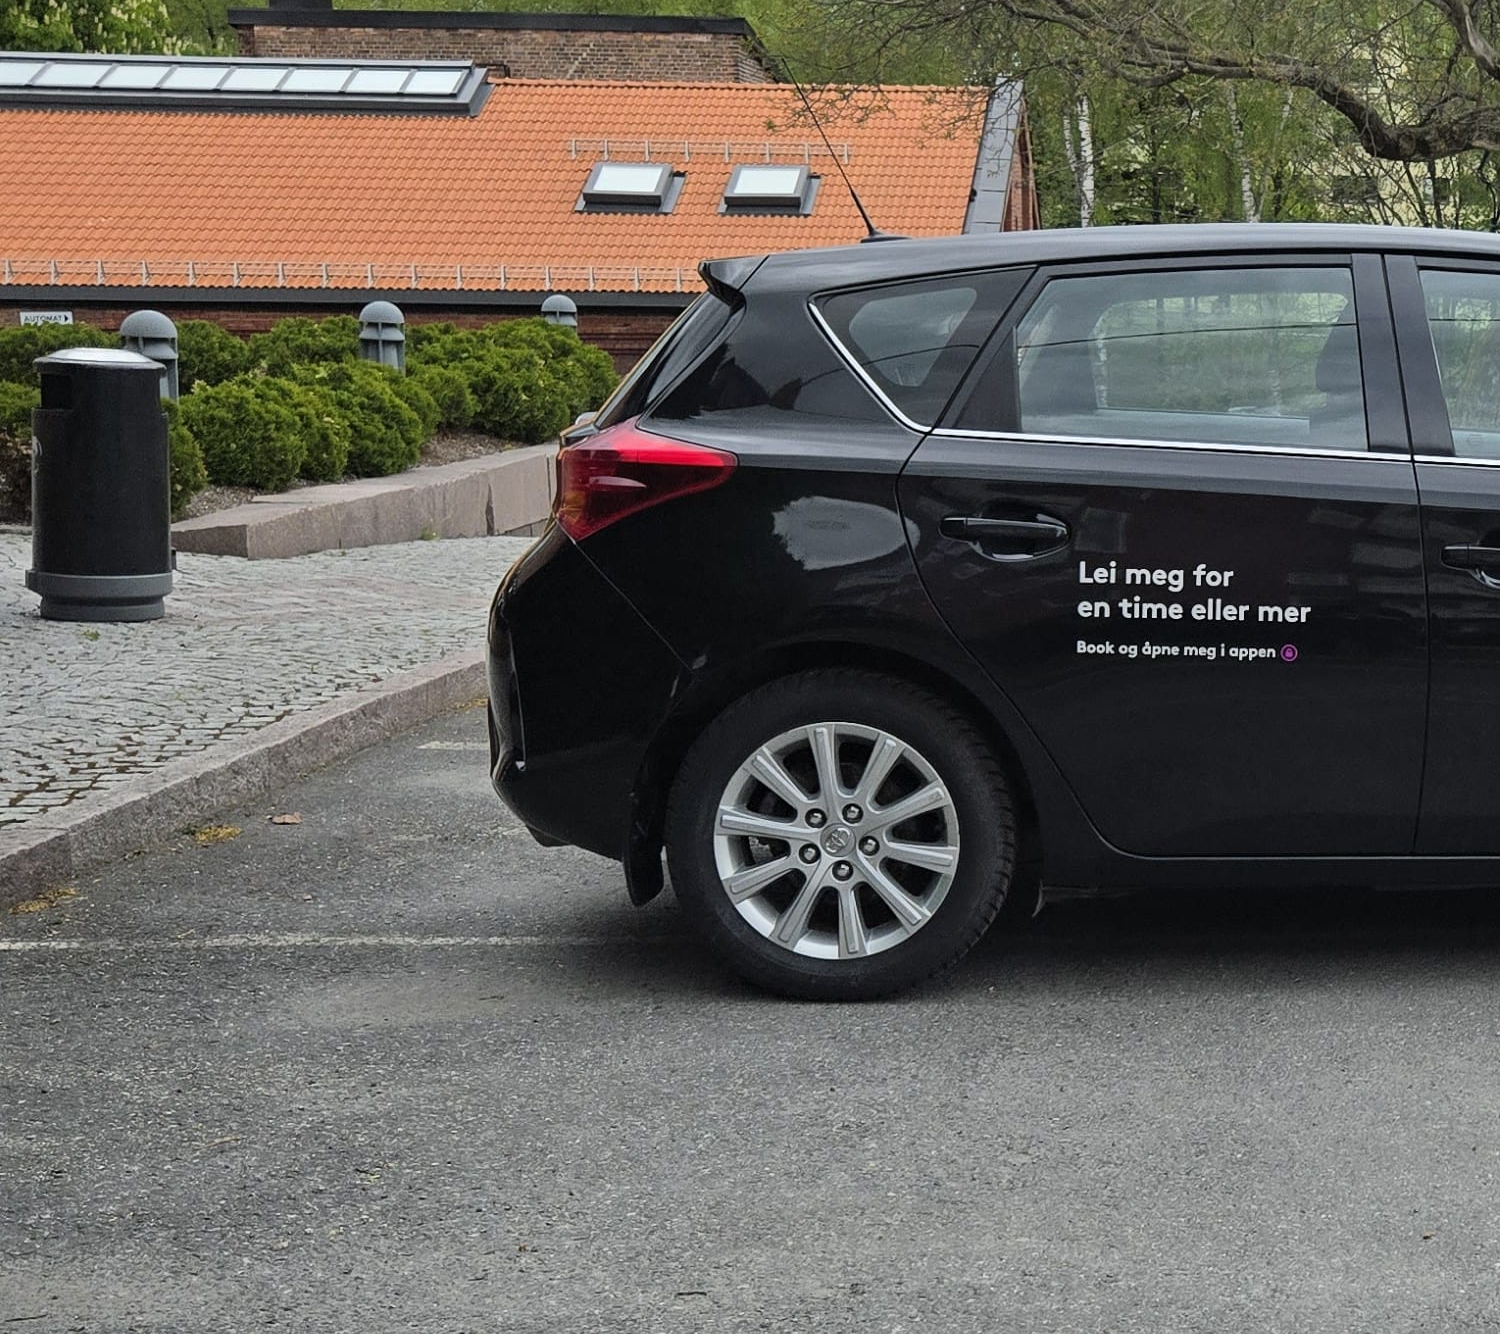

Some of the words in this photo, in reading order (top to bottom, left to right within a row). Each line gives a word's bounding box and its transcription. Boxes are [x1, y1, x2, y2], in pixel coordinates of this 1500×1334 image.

[1079, 560, 1117, 584] Lei
[1125, 568, 1185, 593] meg
[1192, 563, 1234, 587] for
[1077, 600, 1111, 618] en
[1117, 594, 1184, 620] time
[1190, 597, 1250, 621] eller
[1258, 605, 1312, 623] mer
[1076, 640, 1115, 655] Book
[1118, 644, 1138, 659] og
[1141, 641, 1180, 659] åpne
[1183, 645, 1217, 660] meg
[1220, 642, 1226, 657] i
[1228, 647, 1276, 662] appen
